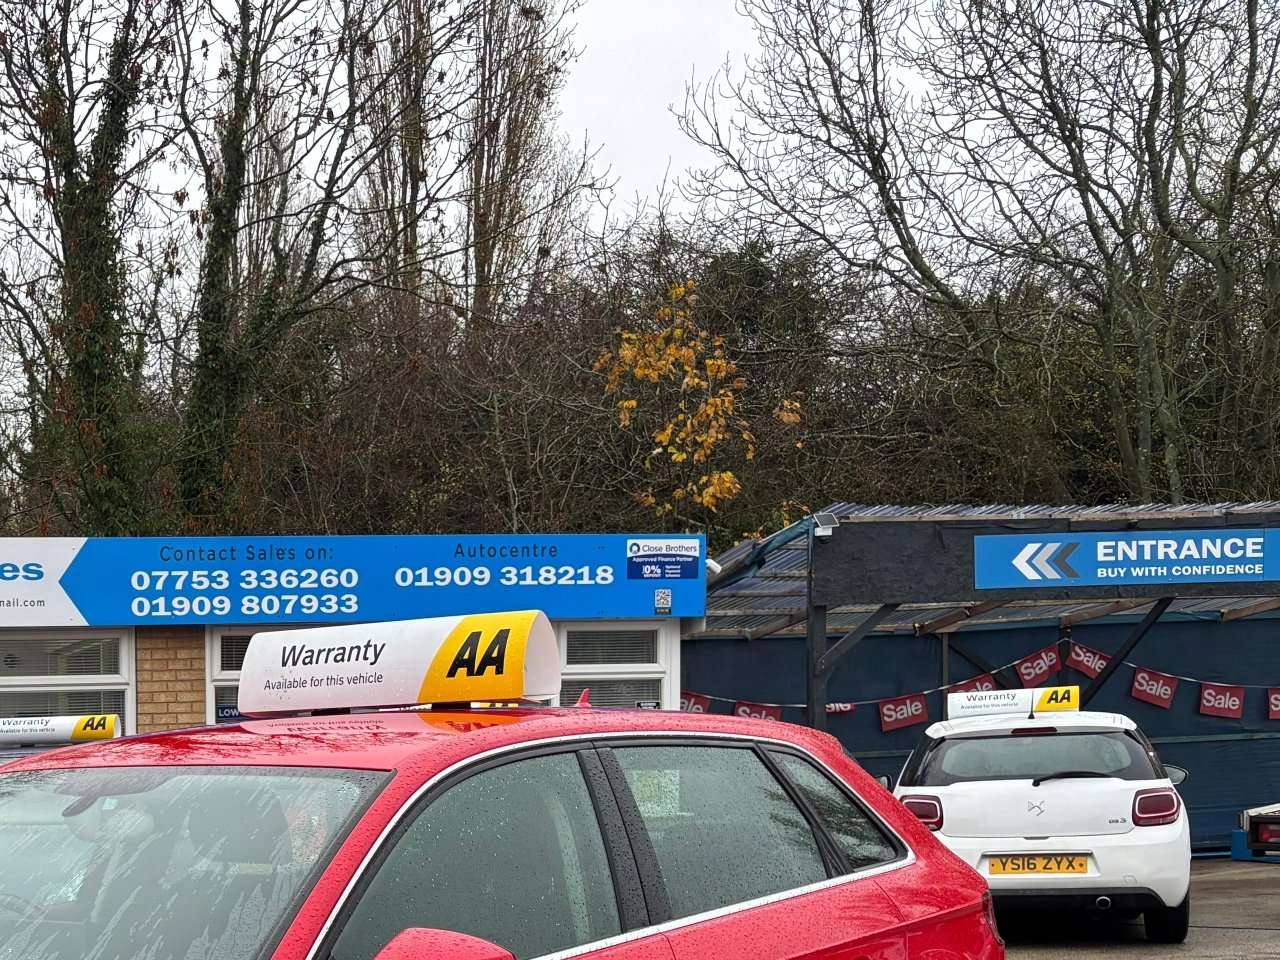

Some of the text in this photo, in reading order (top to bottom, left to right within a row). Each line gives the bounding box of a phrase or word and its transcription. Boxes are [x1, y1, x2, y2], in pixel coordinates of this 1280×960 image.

[159, 543, 334, 562] Contact Sales on:
[454, 543, 558, 558] Autocentre
[665, 544, 697, 552] Brothers
[1096, 537, 1264, 562] ENTRANCE
[131, 568, 359, 591] 07753 336260
[395, 565, 614, 587] 01909 318218
[1097, 564, 1263, 578] BUY WITH CONFIDENCE
[131, 594, 359, 617] 01909 807933
[281, 639, 386, 668] Warranty
[446, 629, 510, 679] AA
[1071, 645, 1107, 673] Sale
[1020, 651, 1057, 681] Sale
[264, 671, 383, 691] Available for this vehicle
[1134, 673, 1172, 699] Sale
[681, 697, 704, 713] ale
[966, 693, 1017, 702] Warranty
[1046, 690, 1071, 704] AA
[1202, 689, 1240, 709] Sale
[218, 708, 239, 717] LOW
[882, 700, 923, 723] Sale
[82, 717, 107, 731] AA
[999, 856, 1076, 871] YS16 ZYX
